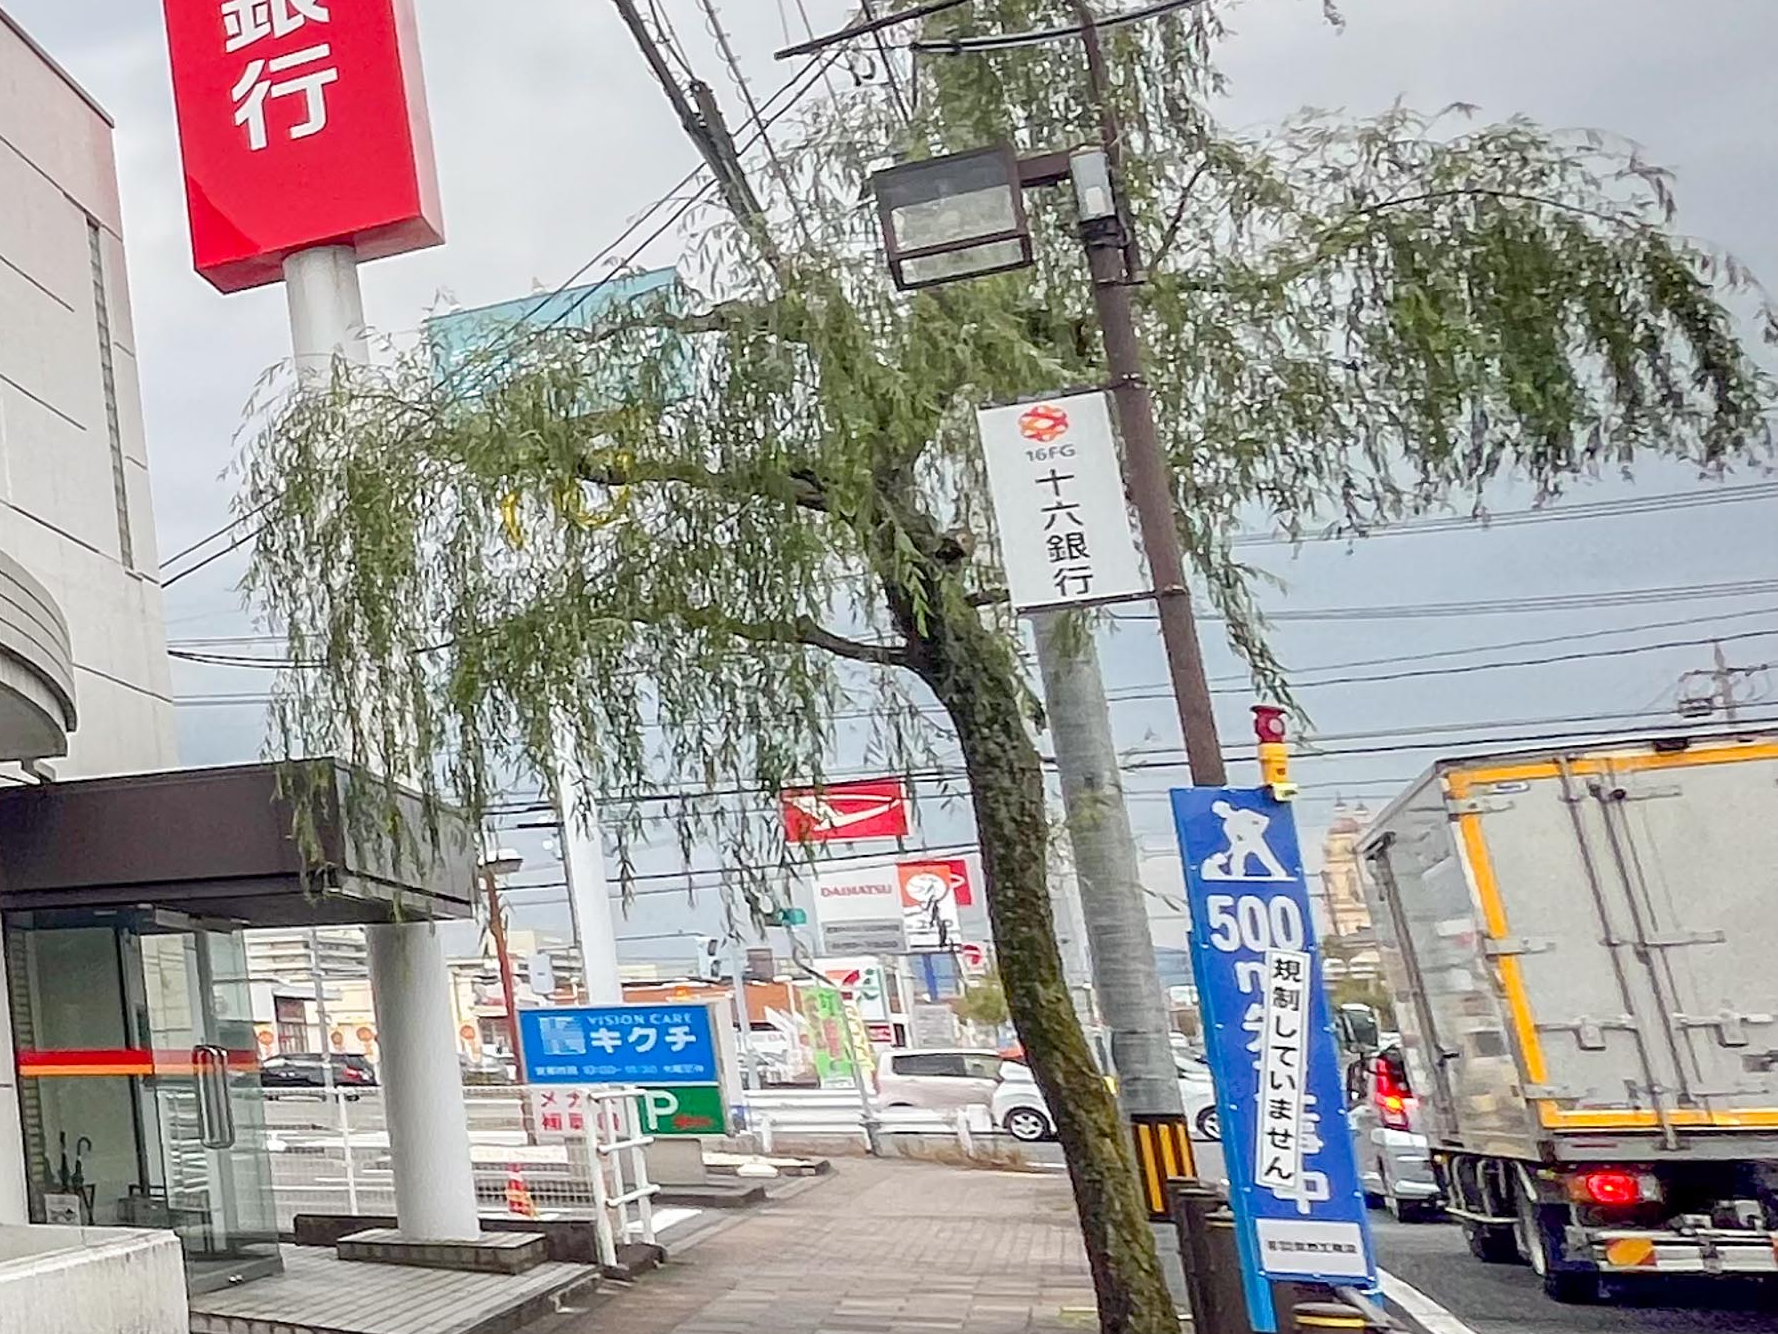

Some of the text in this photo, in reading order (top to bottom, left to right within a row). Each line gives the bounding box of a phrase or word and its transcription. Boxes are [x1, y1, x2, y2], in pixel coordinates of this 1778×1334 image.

[1023, 443, 1077, 463] 16FG
[1034, 468, 1095, 598] 十六銀行
[1206, 894, 1304, 953] 500
[590, 1025, 697, 1055] キクチ
[1263, 957, 1303, 1183] 規制していません
[645, 1089, 679, 1131] P
